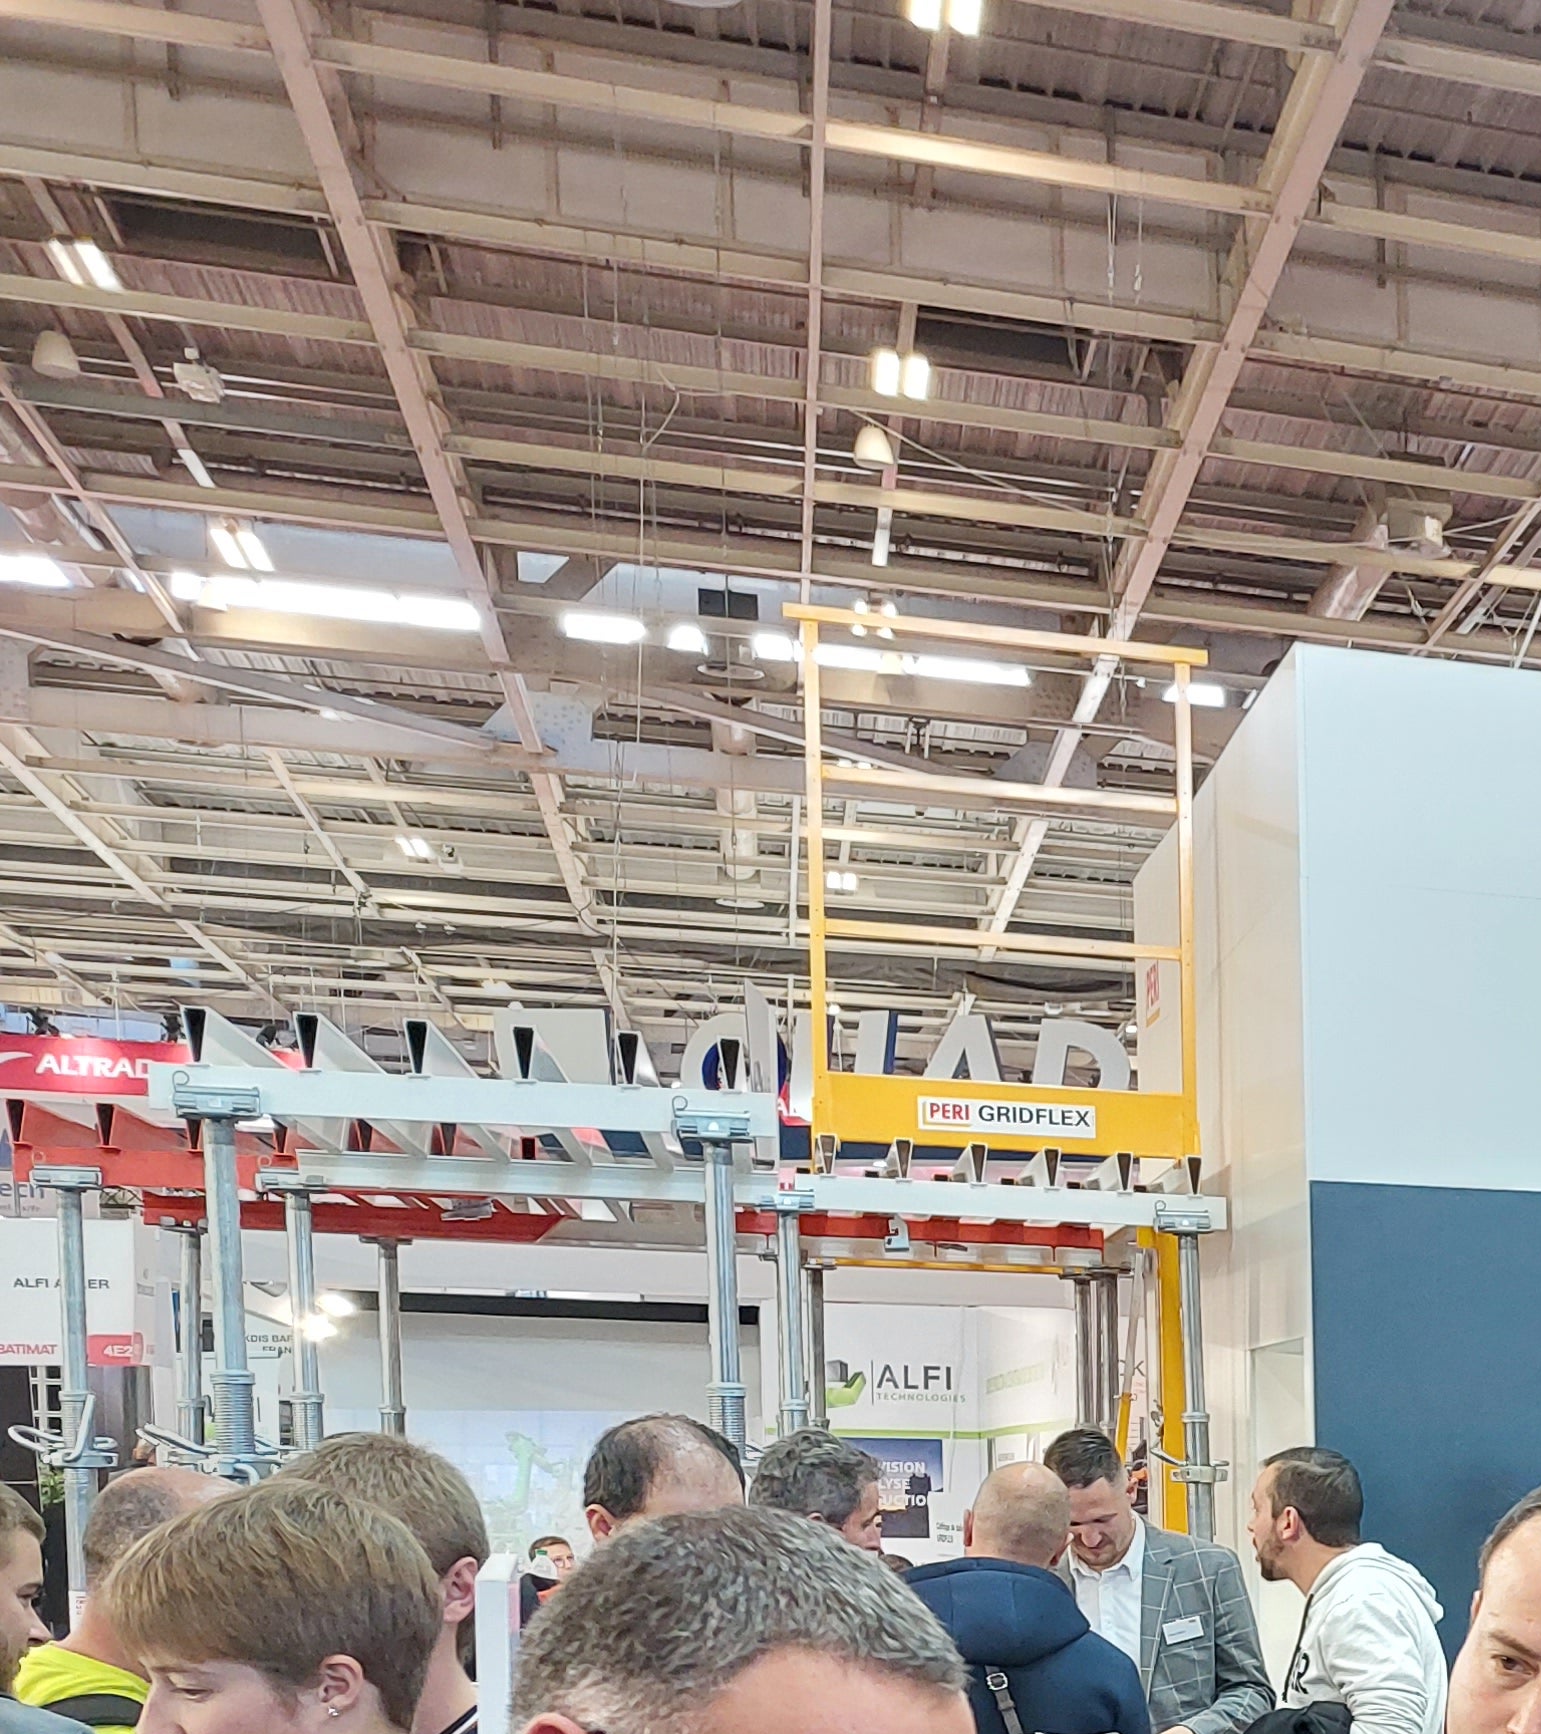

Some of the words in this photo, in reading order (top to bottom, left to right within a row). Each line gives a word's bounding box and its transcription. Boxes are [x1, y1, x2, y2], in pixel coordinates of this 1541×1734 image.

[929, 1102, 970, 1121] PERI
[979, 1104, 1090, 1128] GRIDFLEX
[13, 1276, 50, 1290] ALFI
[876, 1363, 952, 1391] ALFI
[876, 1391, 966, 1404] TECHNOLOGIES
